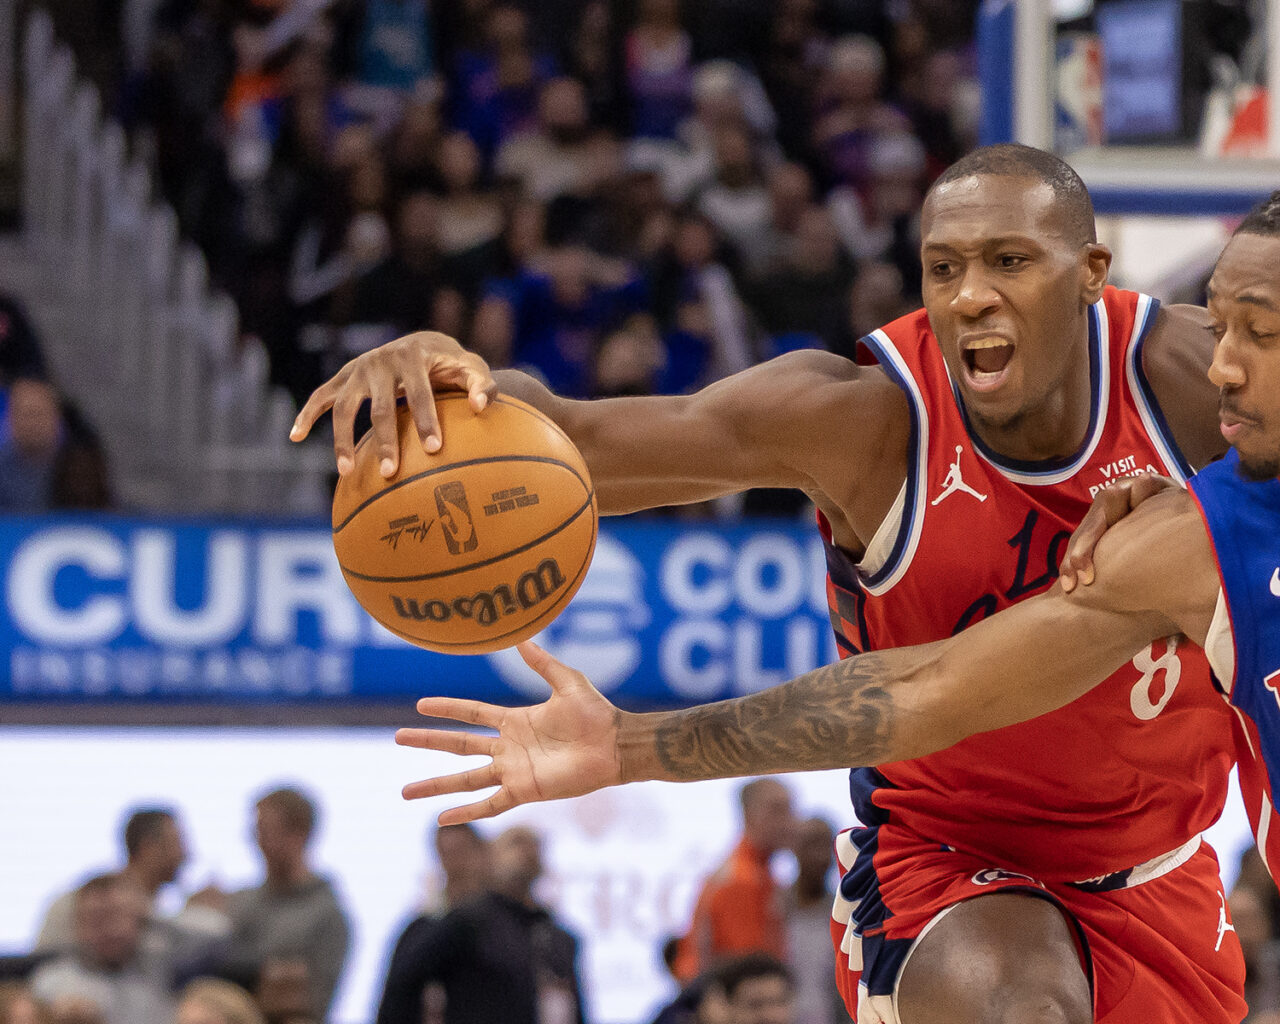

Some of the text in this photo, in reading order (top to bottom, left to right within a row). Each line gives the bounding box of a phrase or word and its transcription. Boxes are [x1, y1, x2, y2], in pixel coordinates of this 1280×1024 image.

[1099, 455, 1136, 478] VISIT
[7, 526, 413, 646] CUR
[390, 557, 567, 627] Wilson
[659, 532, 827, 618] CO
